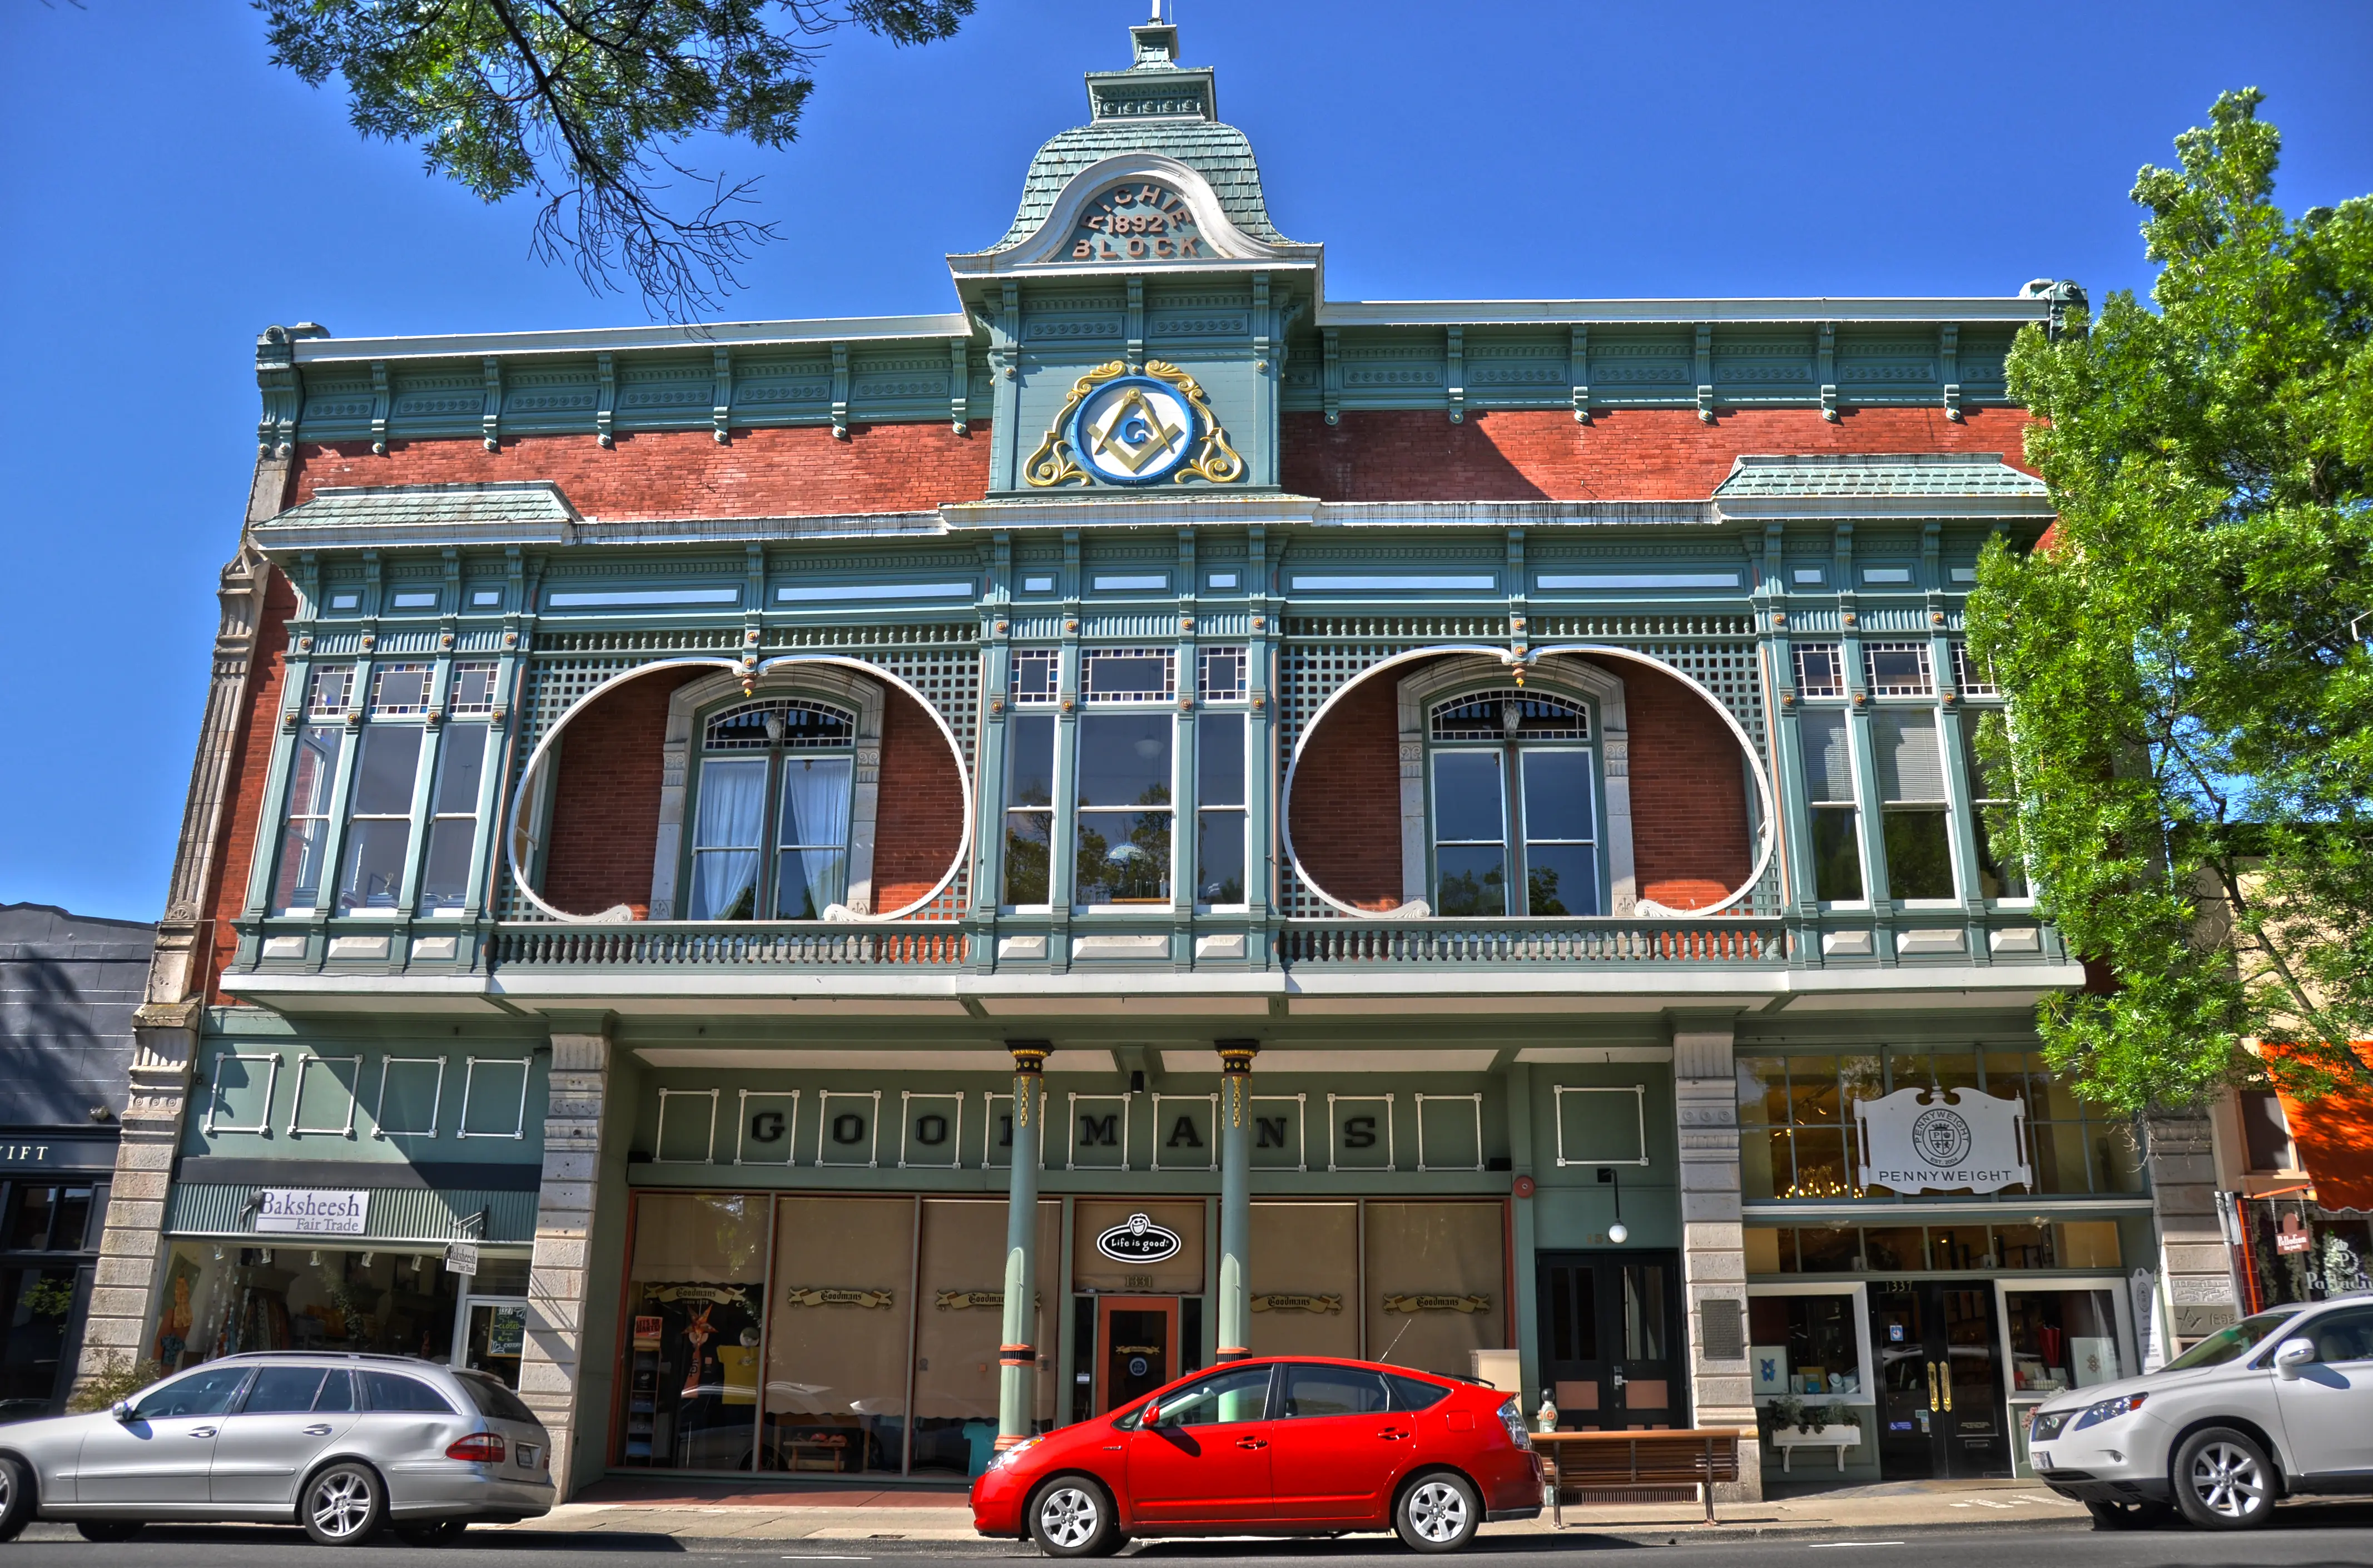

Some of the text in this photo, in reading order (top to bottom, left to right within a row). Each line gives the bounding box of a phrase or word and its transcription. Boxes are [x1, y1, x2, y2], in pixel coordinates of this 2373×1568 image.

[1081, 185, 1192, 230] RICHIE
[1108, 215, 1164, 235] 1892
[1072, 236, 1198, 259] BLOCK
[1120, 417, 1145, 443] G
[1914, 1111, 1969, 1144] PENNYWEIGHT
[0, 1146, 49, 1160] IFT
[1879, 1170, 2012, 1182] PENNYWEIGHT
[258, 1192, 360, 1217] Baksheesh
[295, 1218, 359, 1232] Fair Trade
[1111, 1238, 1129, 1247] Life
[1125, 1275, 1153, 1287] 1331
[676, 1286, 716, 1297] Goodmans
[820, 1291, 862, 1301] Goodmans
[1268, 1296, 1310, 1307] Goodmans
[1416, 1296, 1459, 1307] Goodmans
